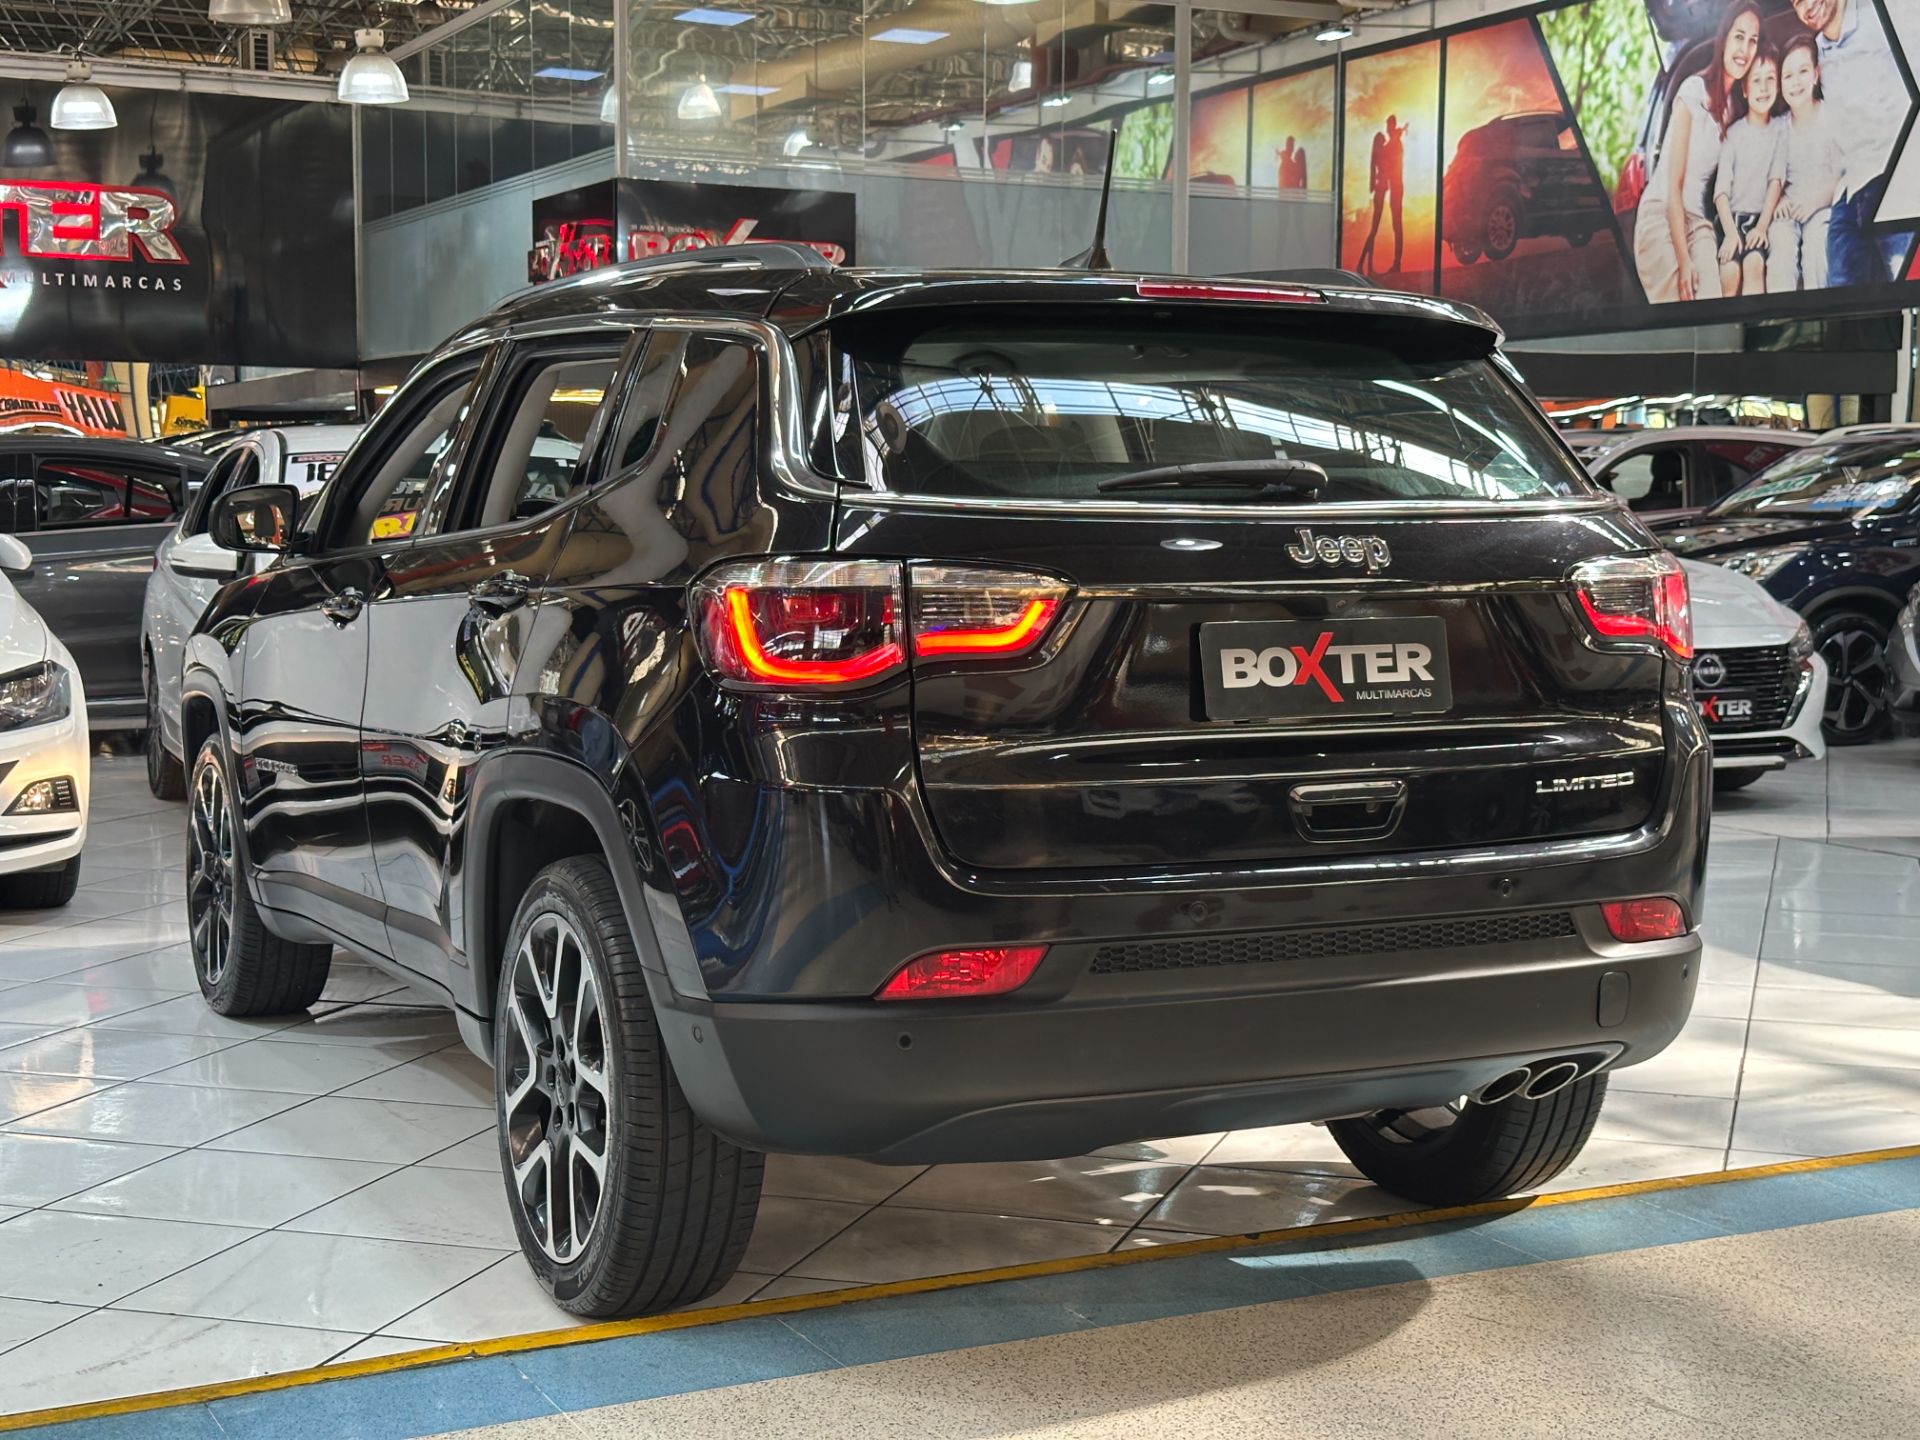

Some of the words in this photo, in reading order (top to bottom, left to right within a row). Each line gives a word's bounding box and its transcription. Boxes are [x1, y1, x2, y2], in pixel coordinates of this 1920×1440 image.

[1, 271, 182, 291] MULTIMARCAS
[1285, 527, 1391, 574] Jeep
[1220, 631, 1435, 703] BOXTER
[1356, 688, 1432, 700] MULTIMARCAS
[1536, 771, 1634, 793] LIMITED
